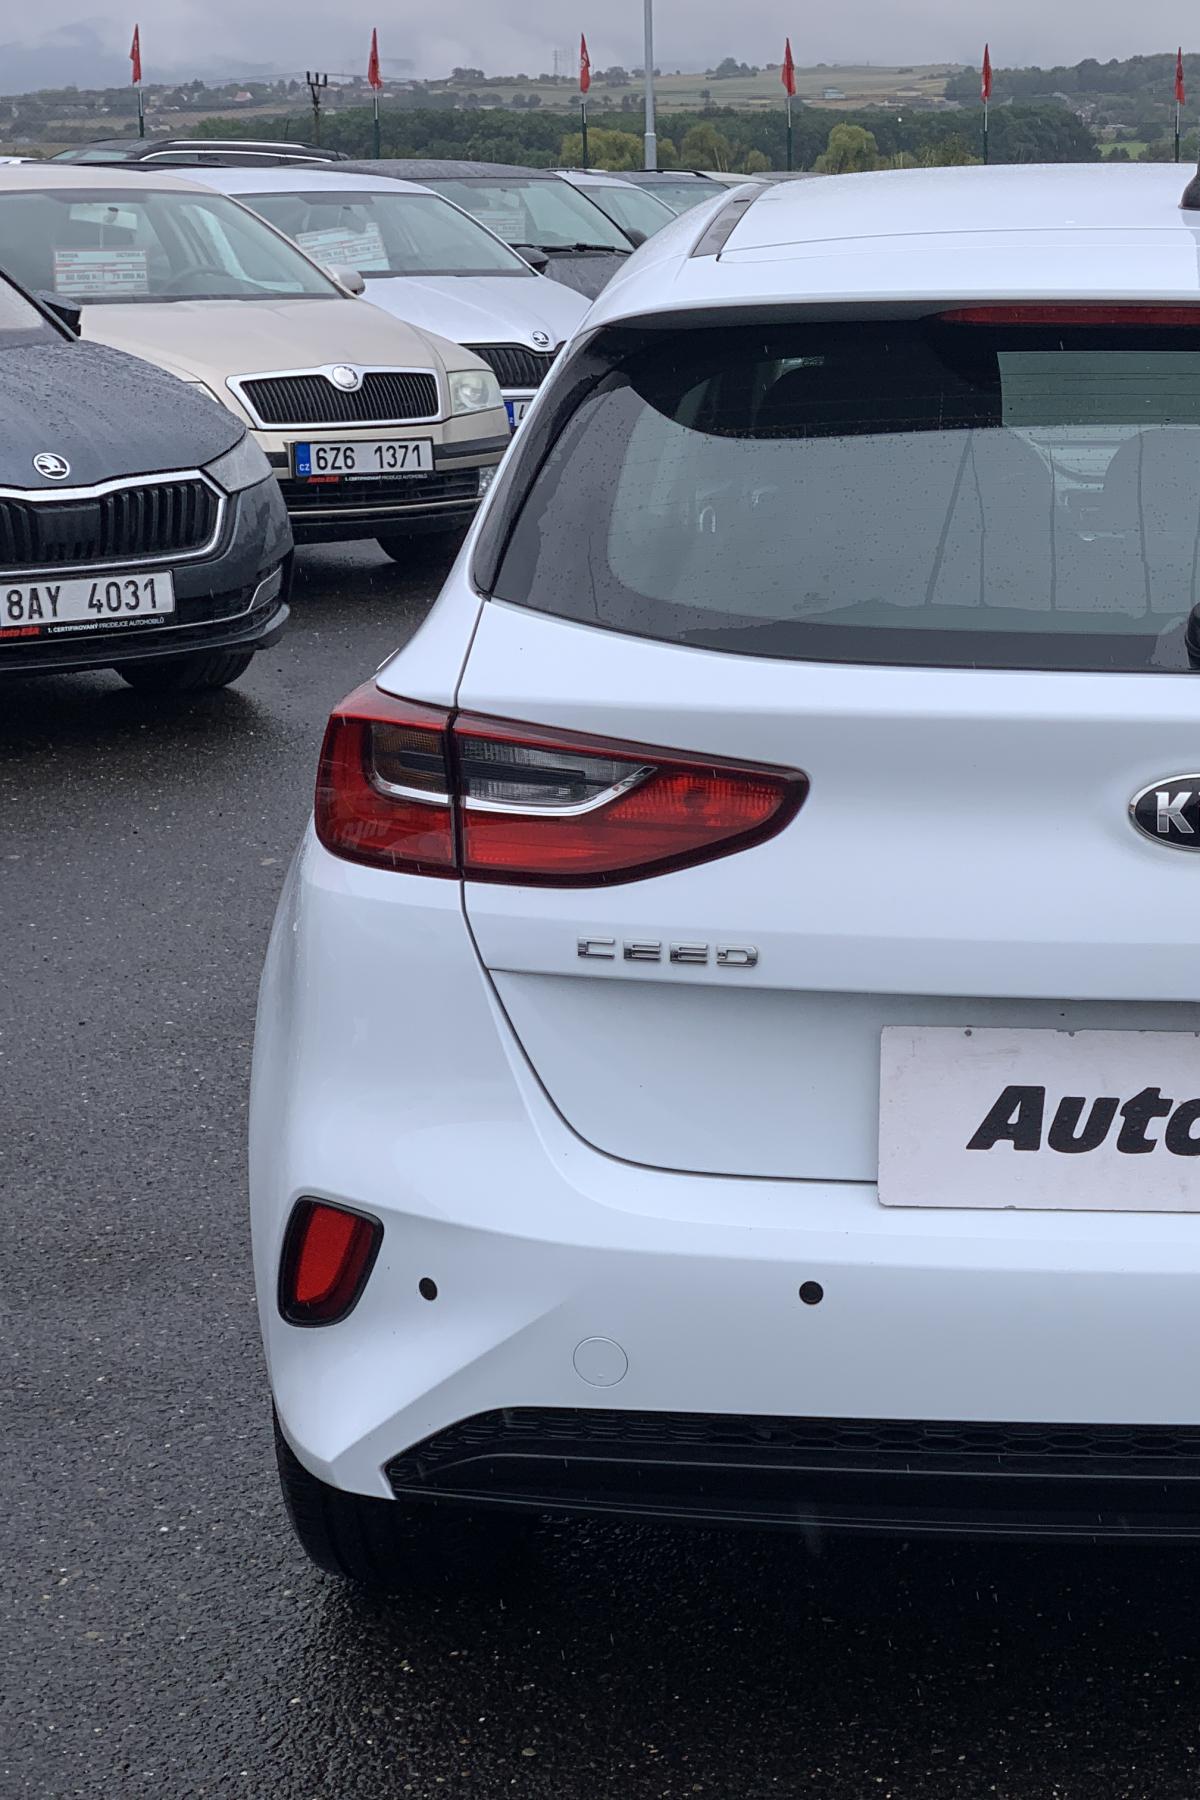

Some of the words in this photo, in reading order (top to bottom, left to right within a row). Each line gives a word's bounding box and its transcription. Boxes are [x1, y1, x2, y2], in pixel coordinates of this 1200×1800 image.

[299, 463, 311, 472] CZ
[315, 446, 356, 471] 6Z6
[374, 444, 422, 469] 1371
[6, 585, 61, 621] 8AY
[87, 577, 157, 614] 4031
[577, 936, 759, 967] CEED
